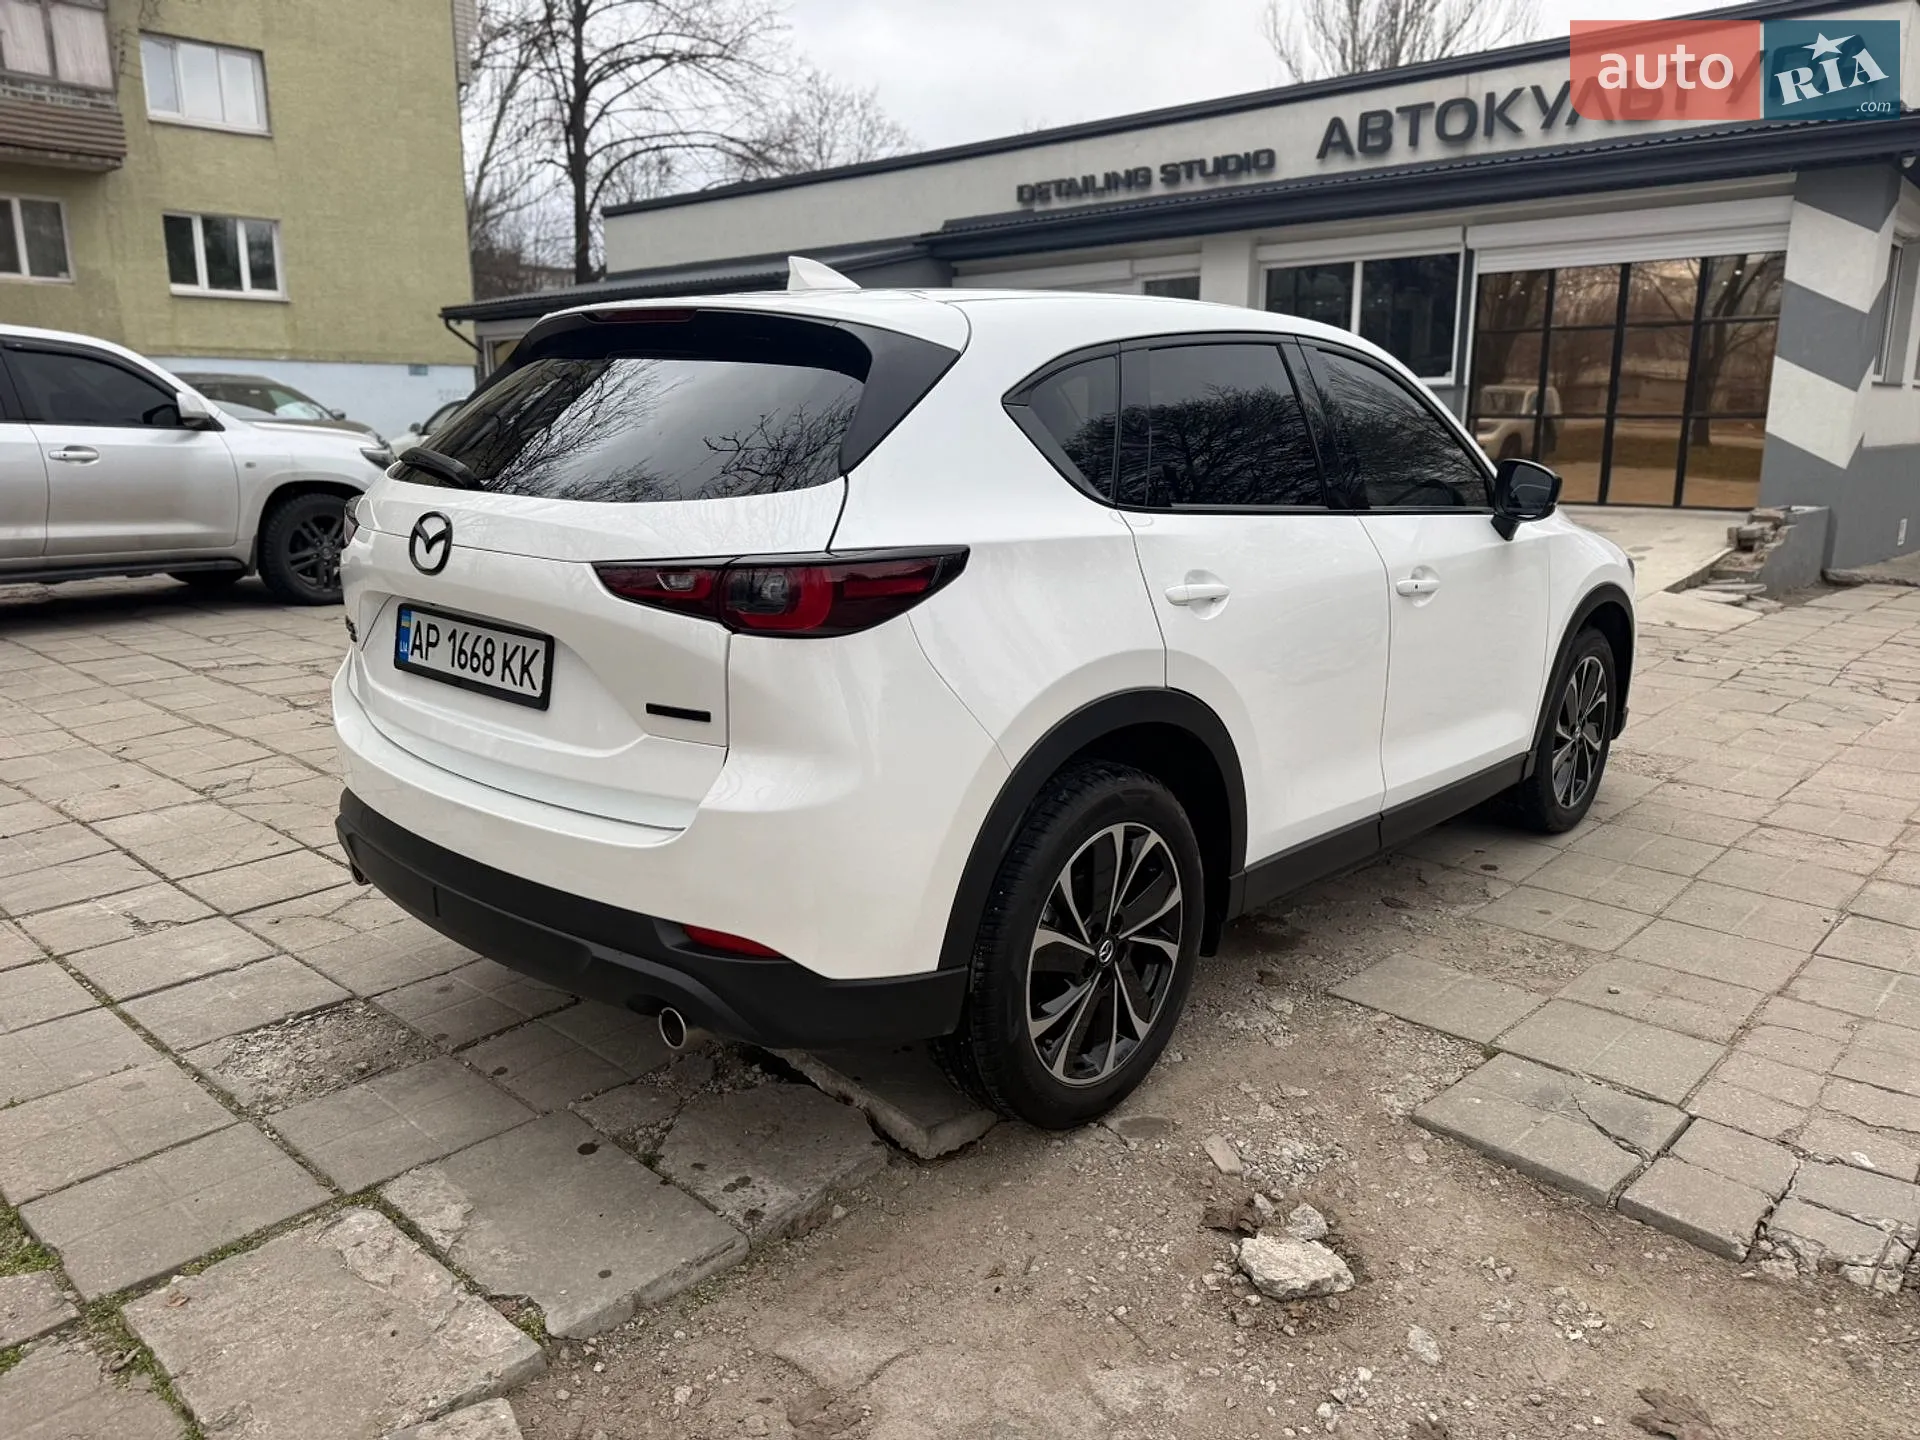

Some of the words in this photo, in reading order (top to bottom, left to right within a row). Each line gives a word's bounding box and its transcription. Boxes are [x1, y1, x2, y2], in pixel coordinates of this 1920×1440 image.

[1016, 166, 1152, 204] DETAILING
[1160, 148, 1276, 187] STUDIO
[410, 620, 440, 661] AP
[448, 628, 496, 677] 1668
[501, 642, 541, 691] KK
